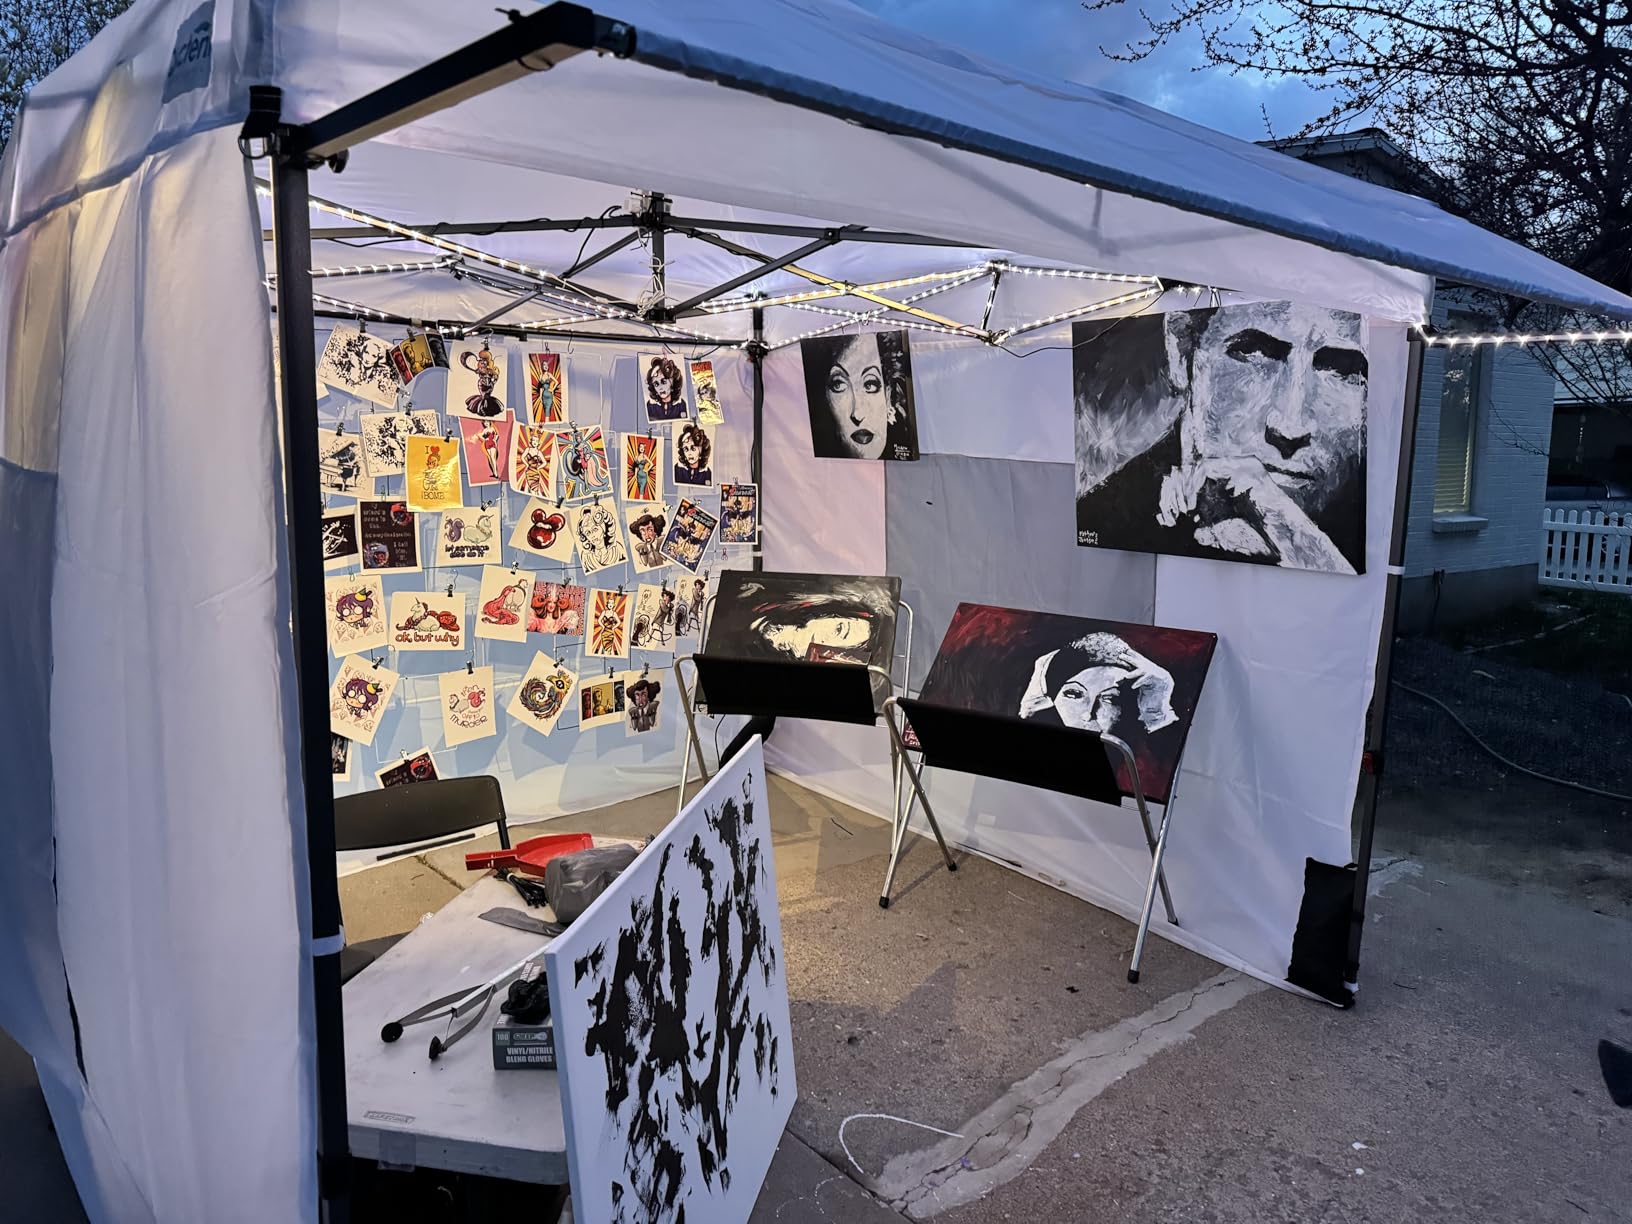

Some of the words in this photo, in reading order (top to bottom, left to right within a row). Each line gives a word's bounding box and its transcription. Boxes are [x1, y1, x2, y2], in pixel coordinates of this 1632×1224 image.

[435, 632, 459, 647] why
[506, 1046, 553, 1055] VINYL/NITRILE
[527, 1055, 553, 1063] GLOVES
